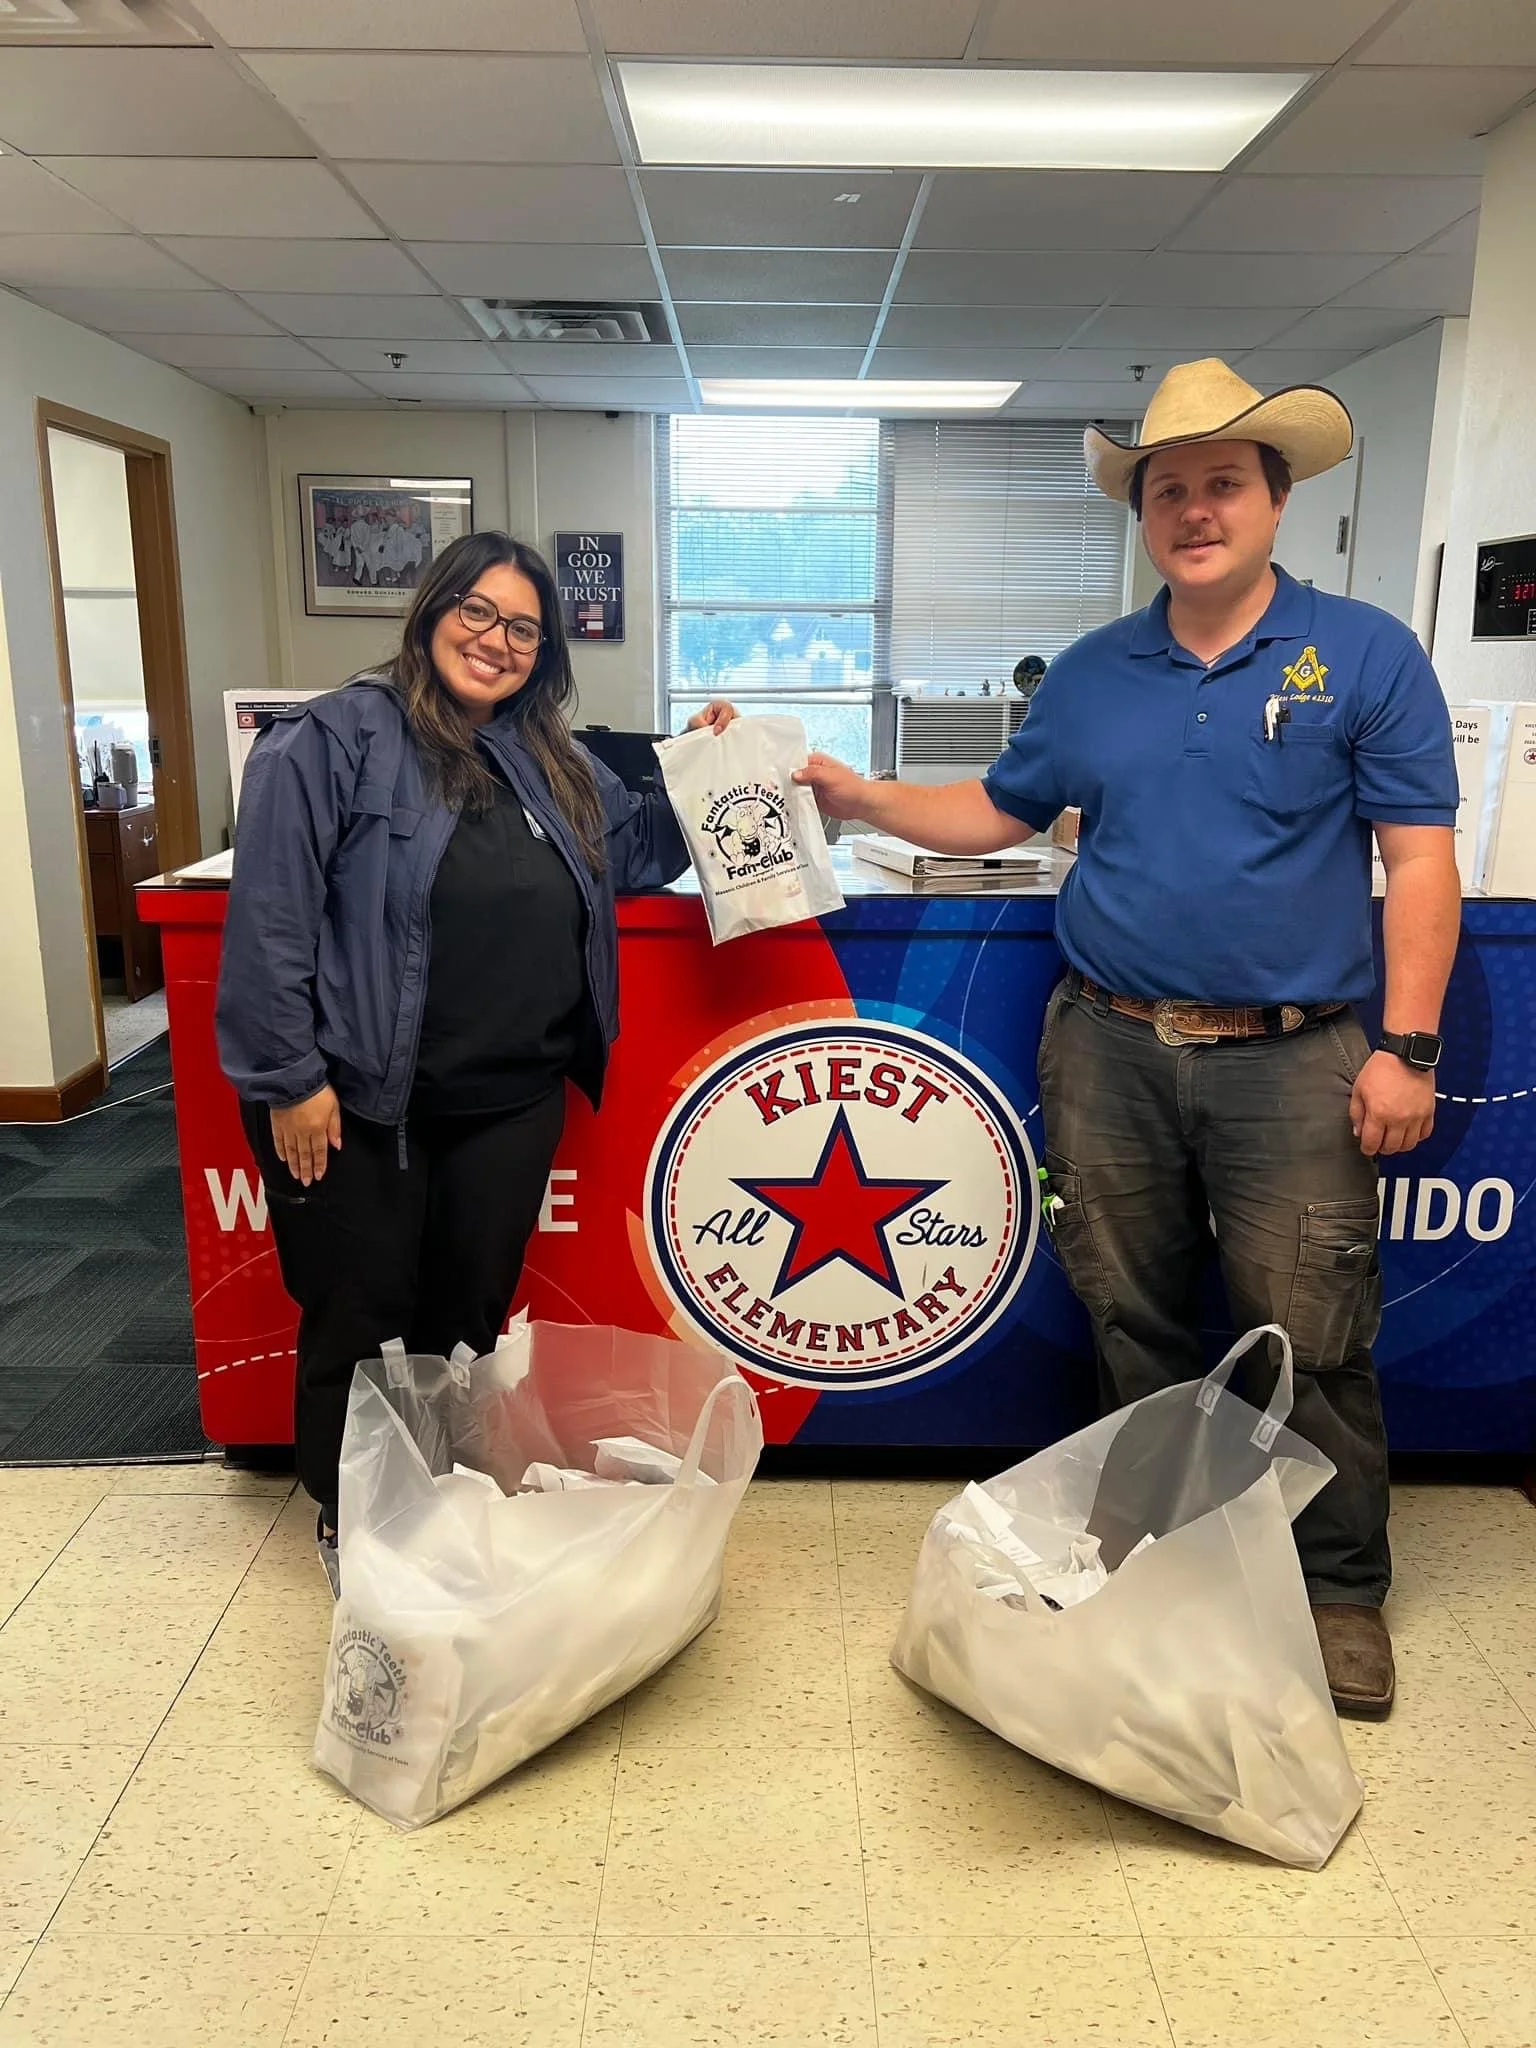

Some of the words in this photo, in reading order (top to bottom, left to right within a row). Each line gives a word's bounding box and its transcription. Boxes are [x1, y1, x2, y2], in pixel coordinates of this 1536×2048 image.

[579, 536, 600, 551] IN
[568, 552, 611, 568] GOD
[575, 569, 606, 585] WE
[560, 586, 621, 602] TRUST
[1300, 665, 1311, 677] G
[1455, 720, 1478, 731] Days
[1467, 734, 1480, 744] be
[701, 785, 749, 833] Fantastic
[754, 783, 785, 810] Teeth
[726, 850, 794, 880] Fan-Club
[745, 1058, 949, 1126] KIEST
[692, 1208, 771, 1246] All
[896, 1208, 988, 1248] Stars
[704, 1262, 968, 1352] ELEMENTARY
[379, 1641, 408, 1686] Teeth
